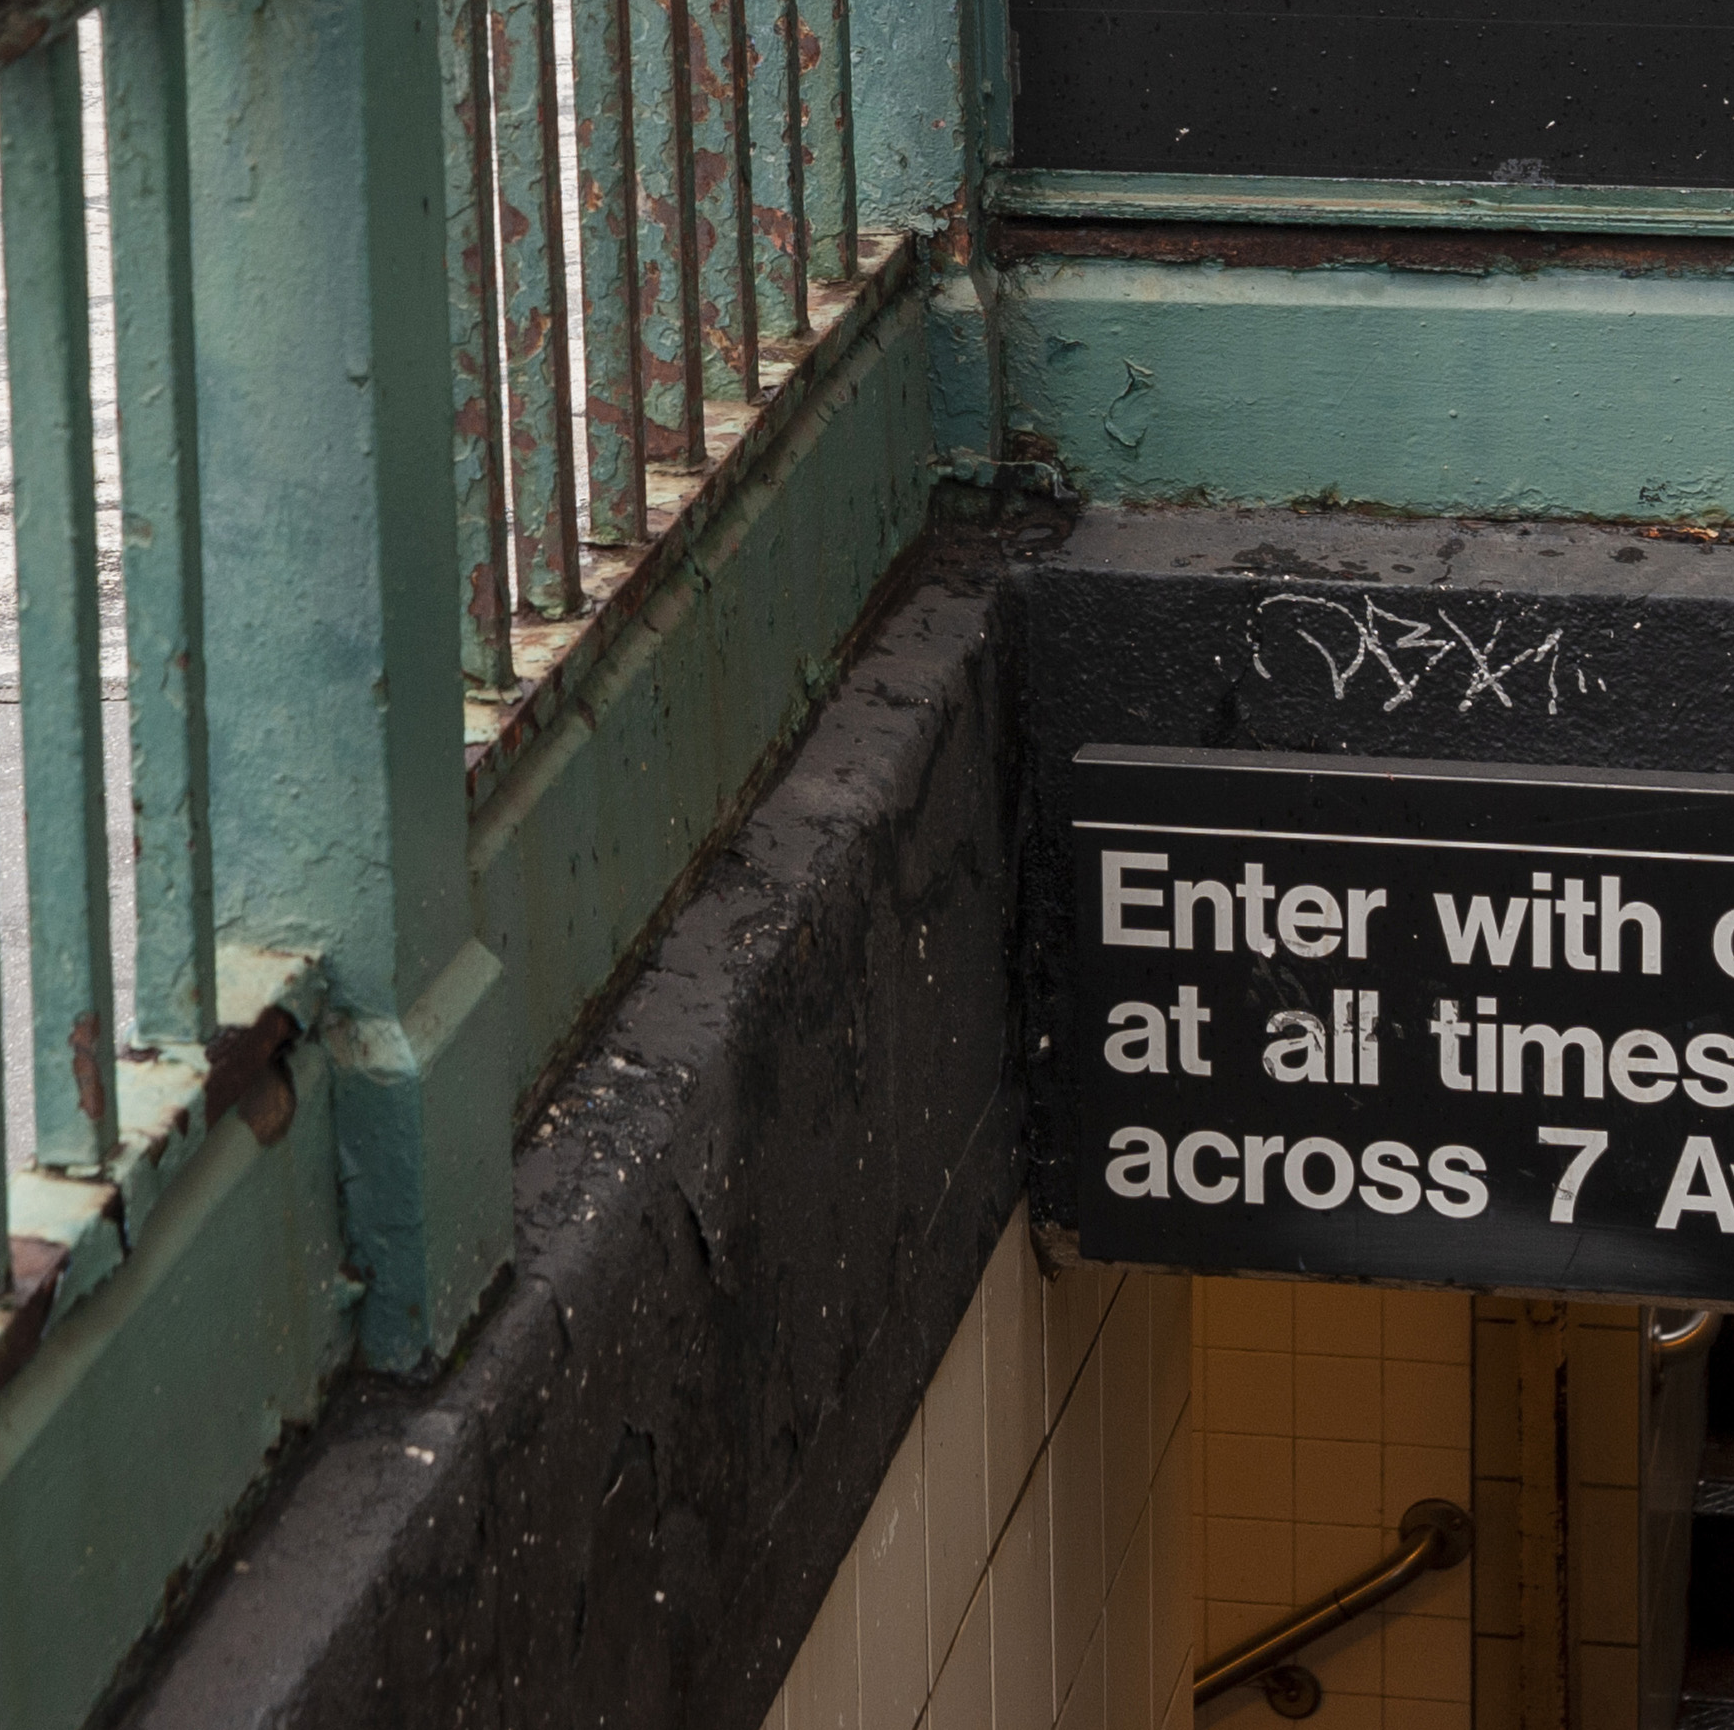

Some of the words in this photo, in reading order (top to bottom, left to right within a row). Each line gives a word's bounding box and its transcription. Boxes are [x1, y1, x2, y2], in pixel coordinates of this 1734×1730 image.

[1102, 850, 1386, 958] Enter
[1434, 875, 1661, 974] with
[1104, 985, 1212, 1075] at
[1264, 989, 1379, 1085] all
[1105, 1126, 1489, 1218] across
[1538, 1126, 1609, 1223] 7
